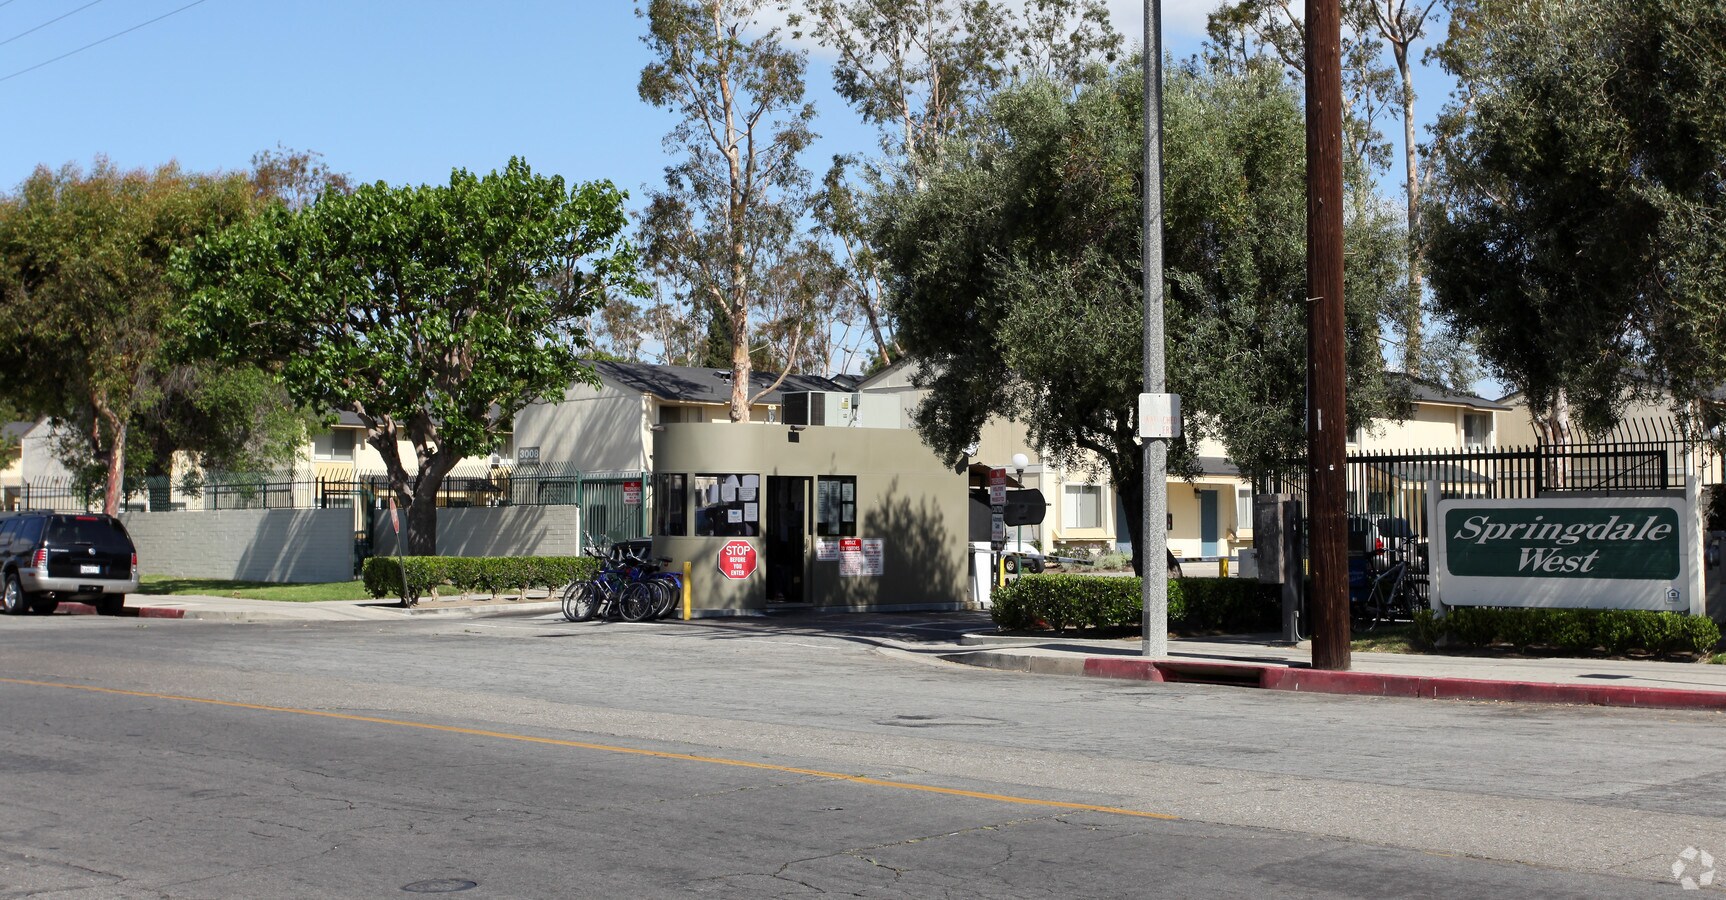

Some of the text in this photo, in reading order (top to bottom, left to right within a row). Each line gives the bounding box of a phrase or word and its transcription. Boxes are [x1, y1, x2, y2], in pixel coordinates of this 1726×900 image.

[520, 449, 539, 458] 3008
[1454, 516, 1672, 545] Springdale
[725, 545, 751, 556] STOP
[1518, 547, 1600, 573] West
